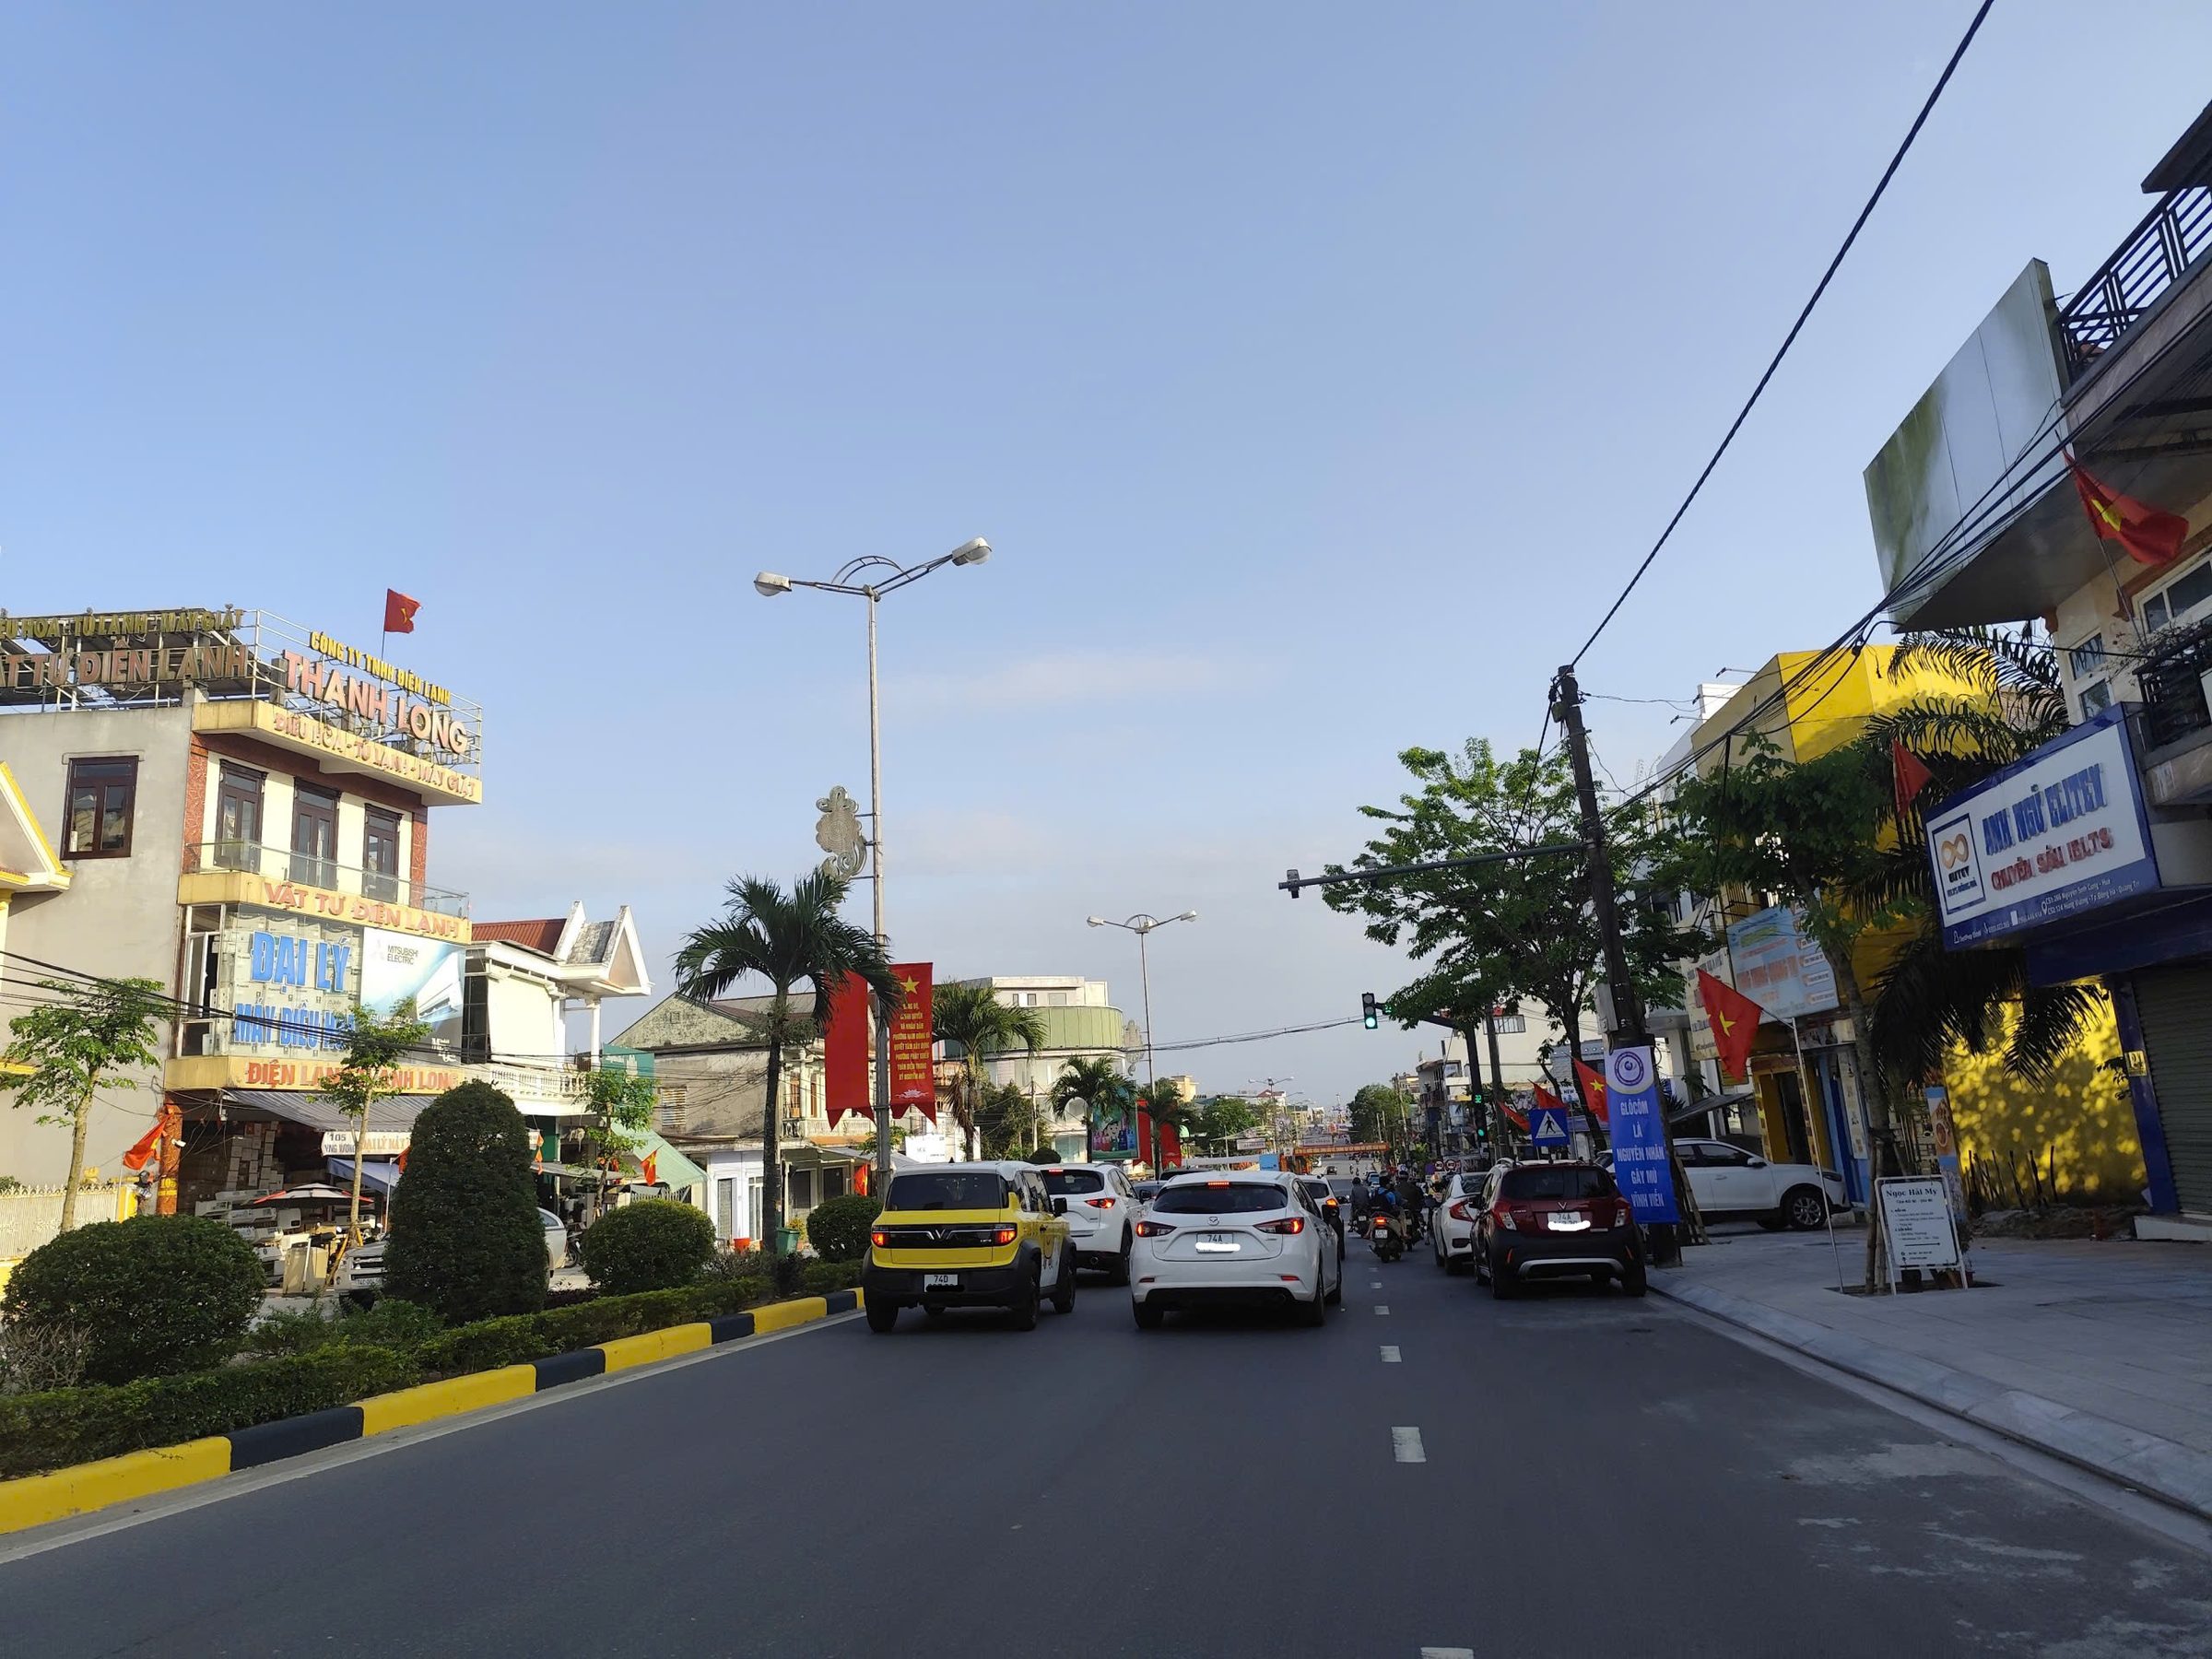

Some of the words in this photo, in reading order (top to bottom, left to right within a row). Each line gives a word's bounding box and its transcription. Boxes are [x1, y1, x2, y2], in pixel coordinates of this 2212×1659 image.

[347, 646, 362, 667] TY
[365, 653, 395, 681] TNHH
[396, 696, 469, 754] LONG
[2066, 827, 2114, 863] IELTS
[265, 882, 309, 910] VẬT
[351, 900, 402, 927] ĐIỆN
[250, 930, 308, 994] ĐẠI
[315, 936, 351, 993] LÝ
[246, 1059, 296, 1088] ĐIỆN
[1207, 1234, 1223, 1242] 74A
